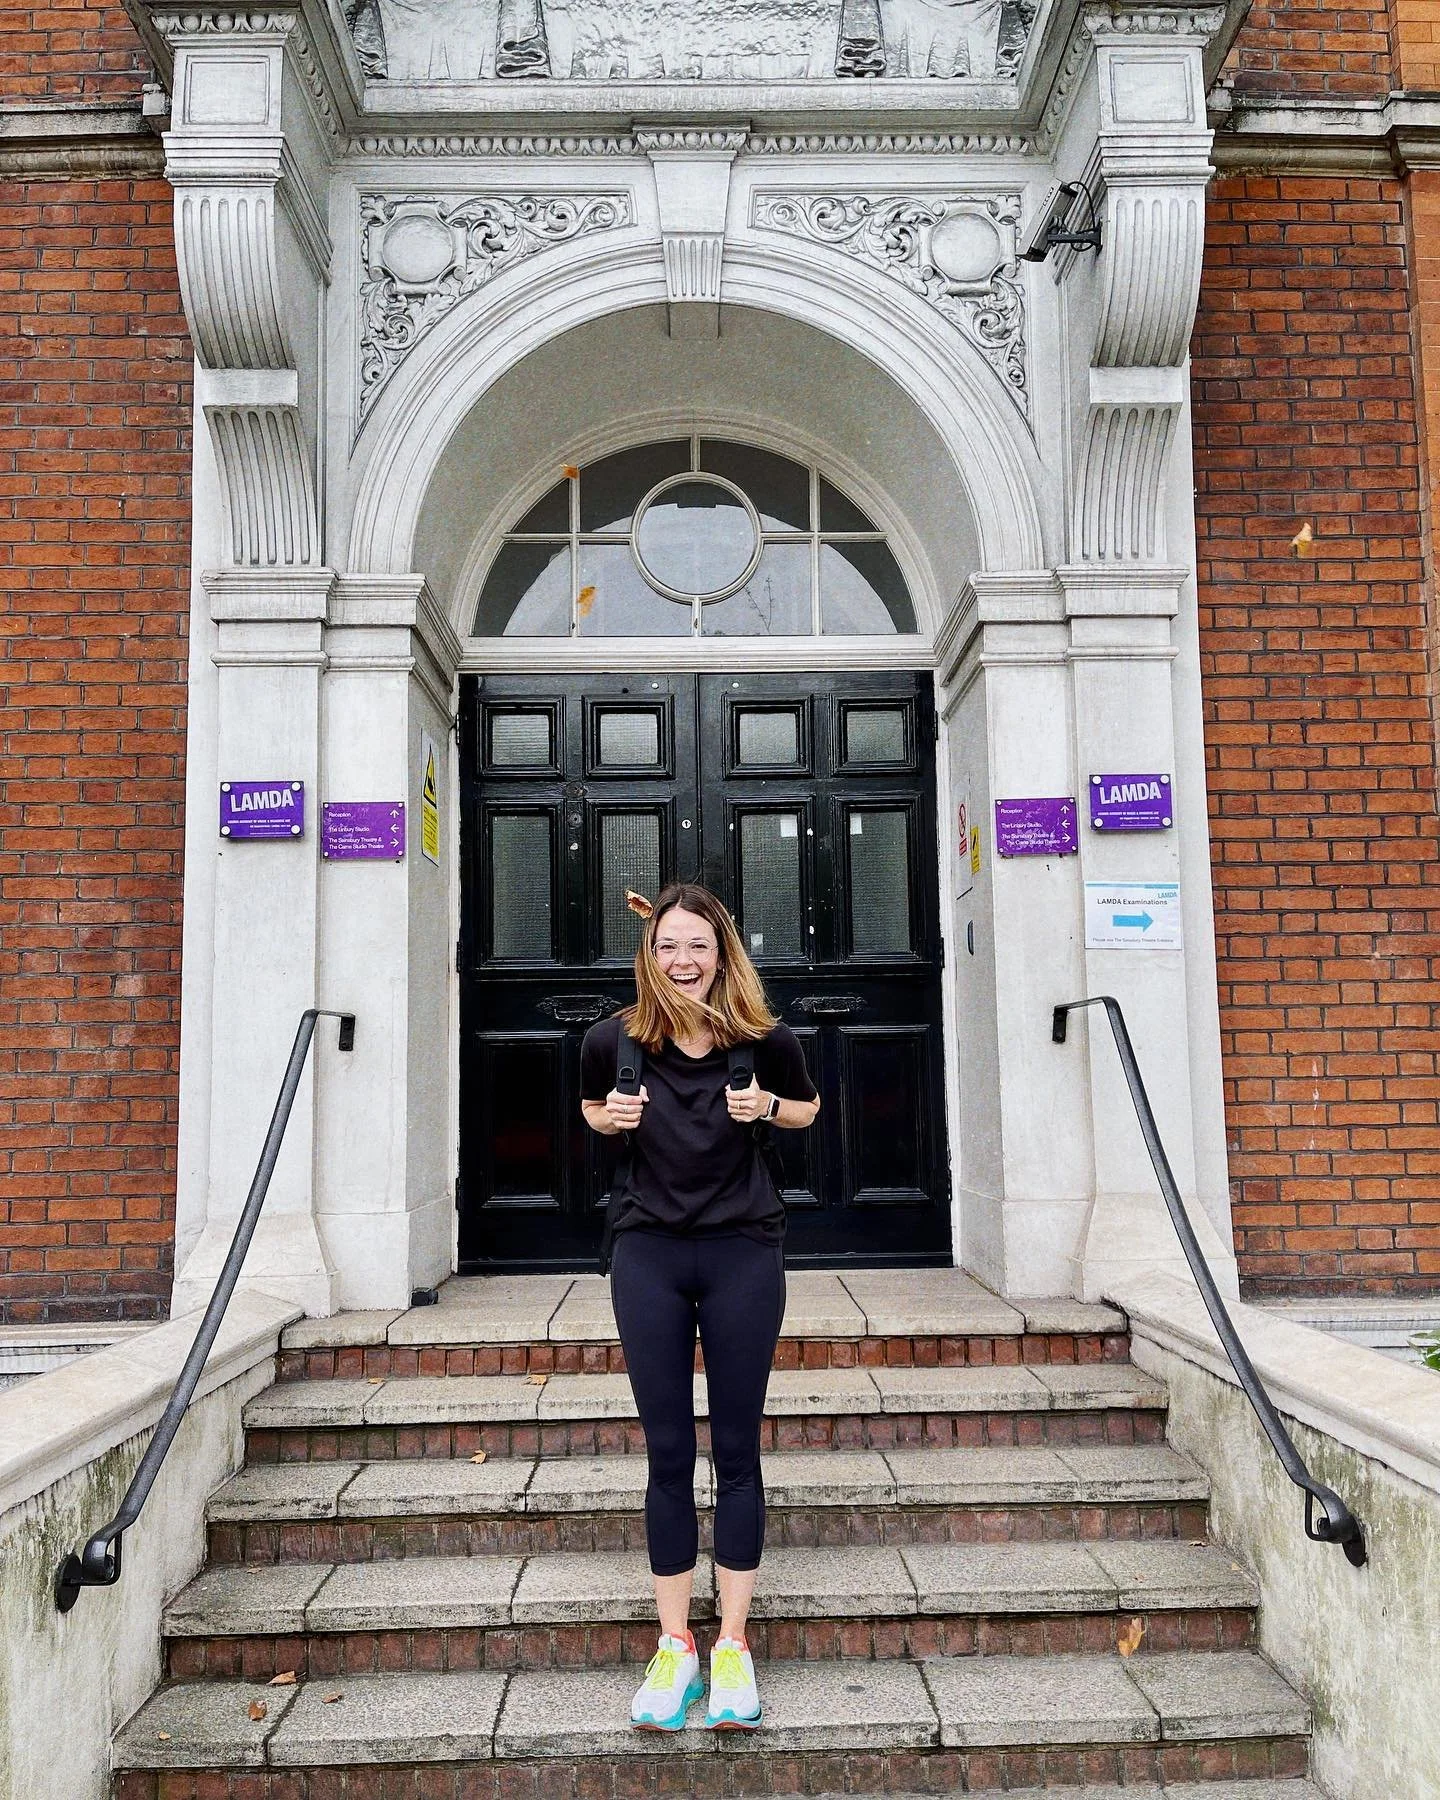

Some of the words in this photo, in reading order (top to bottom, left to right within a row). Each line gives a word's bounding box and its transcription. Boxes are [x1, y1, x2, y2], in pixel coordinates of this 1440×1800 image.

[230, 789, 295, 812] LAMDA
[1099, 781, 1162, 804] LAMDA
[1157, 891, 1178, 899] LAMDA
